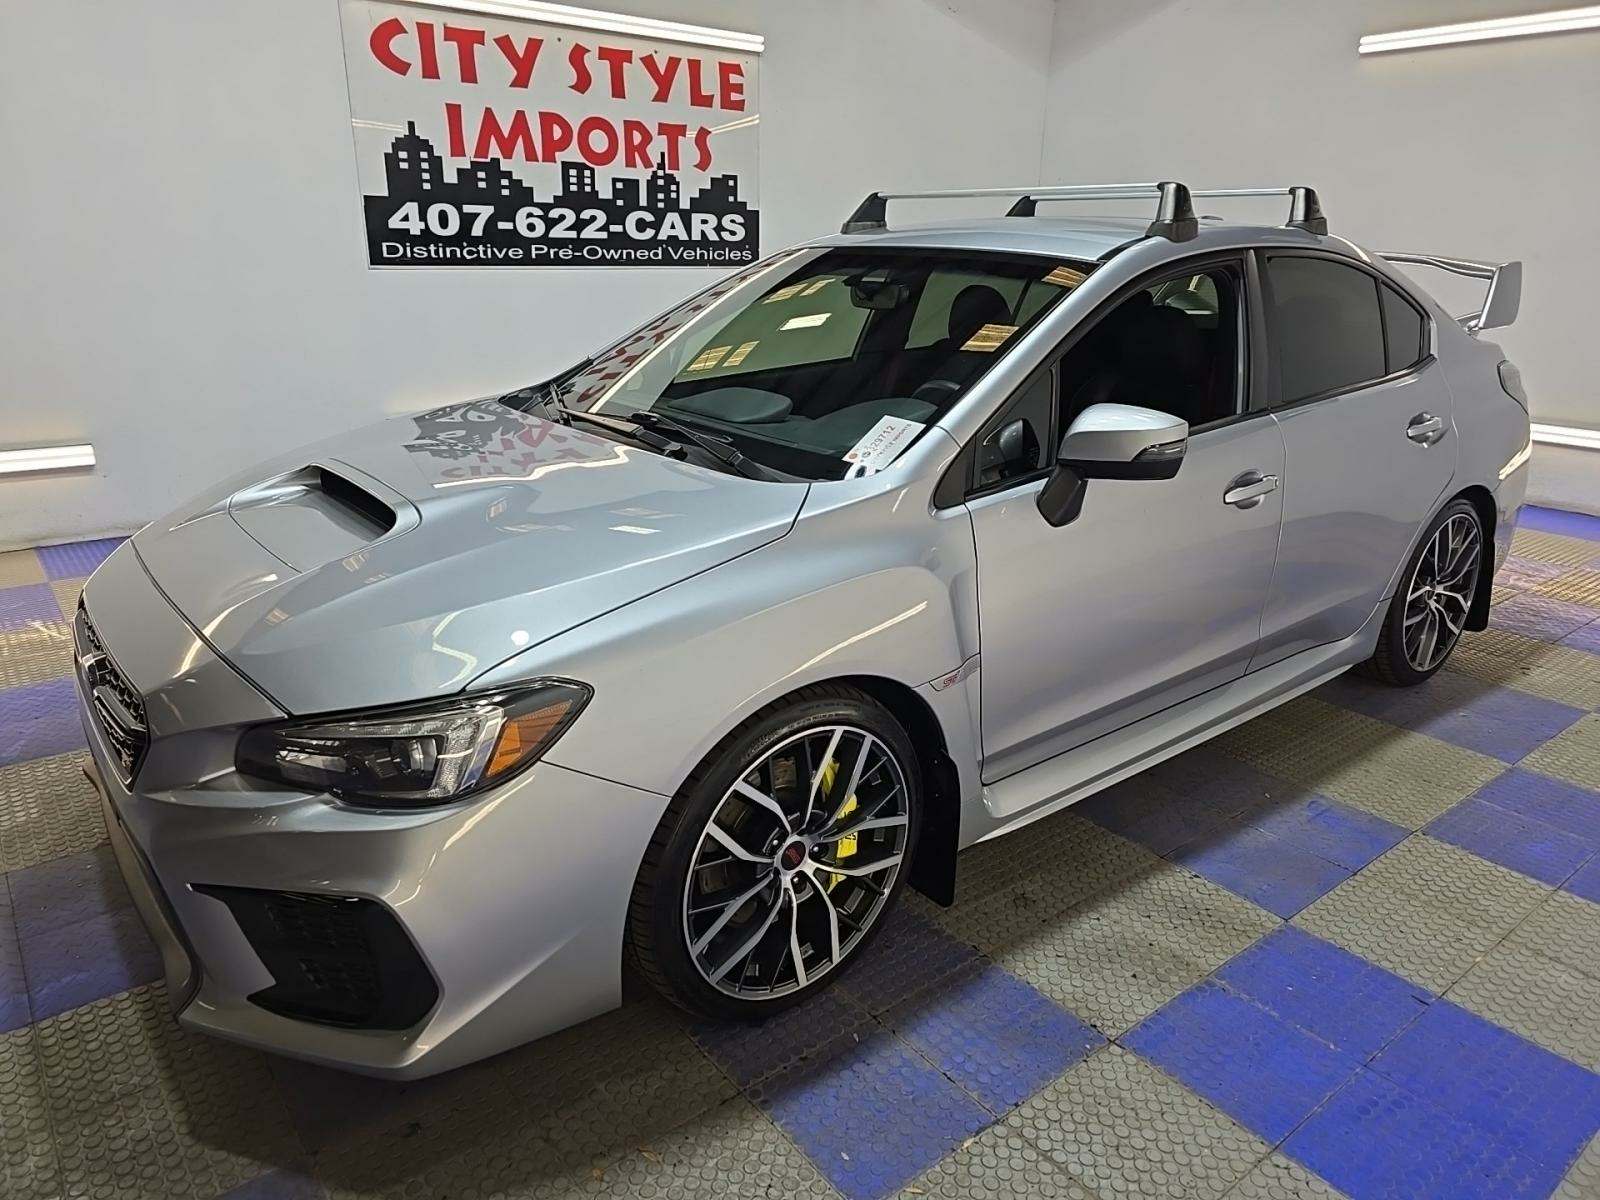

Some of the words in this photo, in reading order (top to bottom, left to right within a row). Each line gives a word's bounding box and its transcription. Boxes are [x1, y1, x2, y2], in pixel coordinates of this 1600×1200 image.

[370, 17, 544, 88] CITY
[568, 43, 746, 112] STYLE
[445, 102, 712, 172] IMPORTS
[387, 201, 746, 242] 407-622-CARS
[381, 242, 524, 260] Distinctive
[531, 244, 662, 261] Pre-Owned
[667, 246, 752, 261] Vehicles
